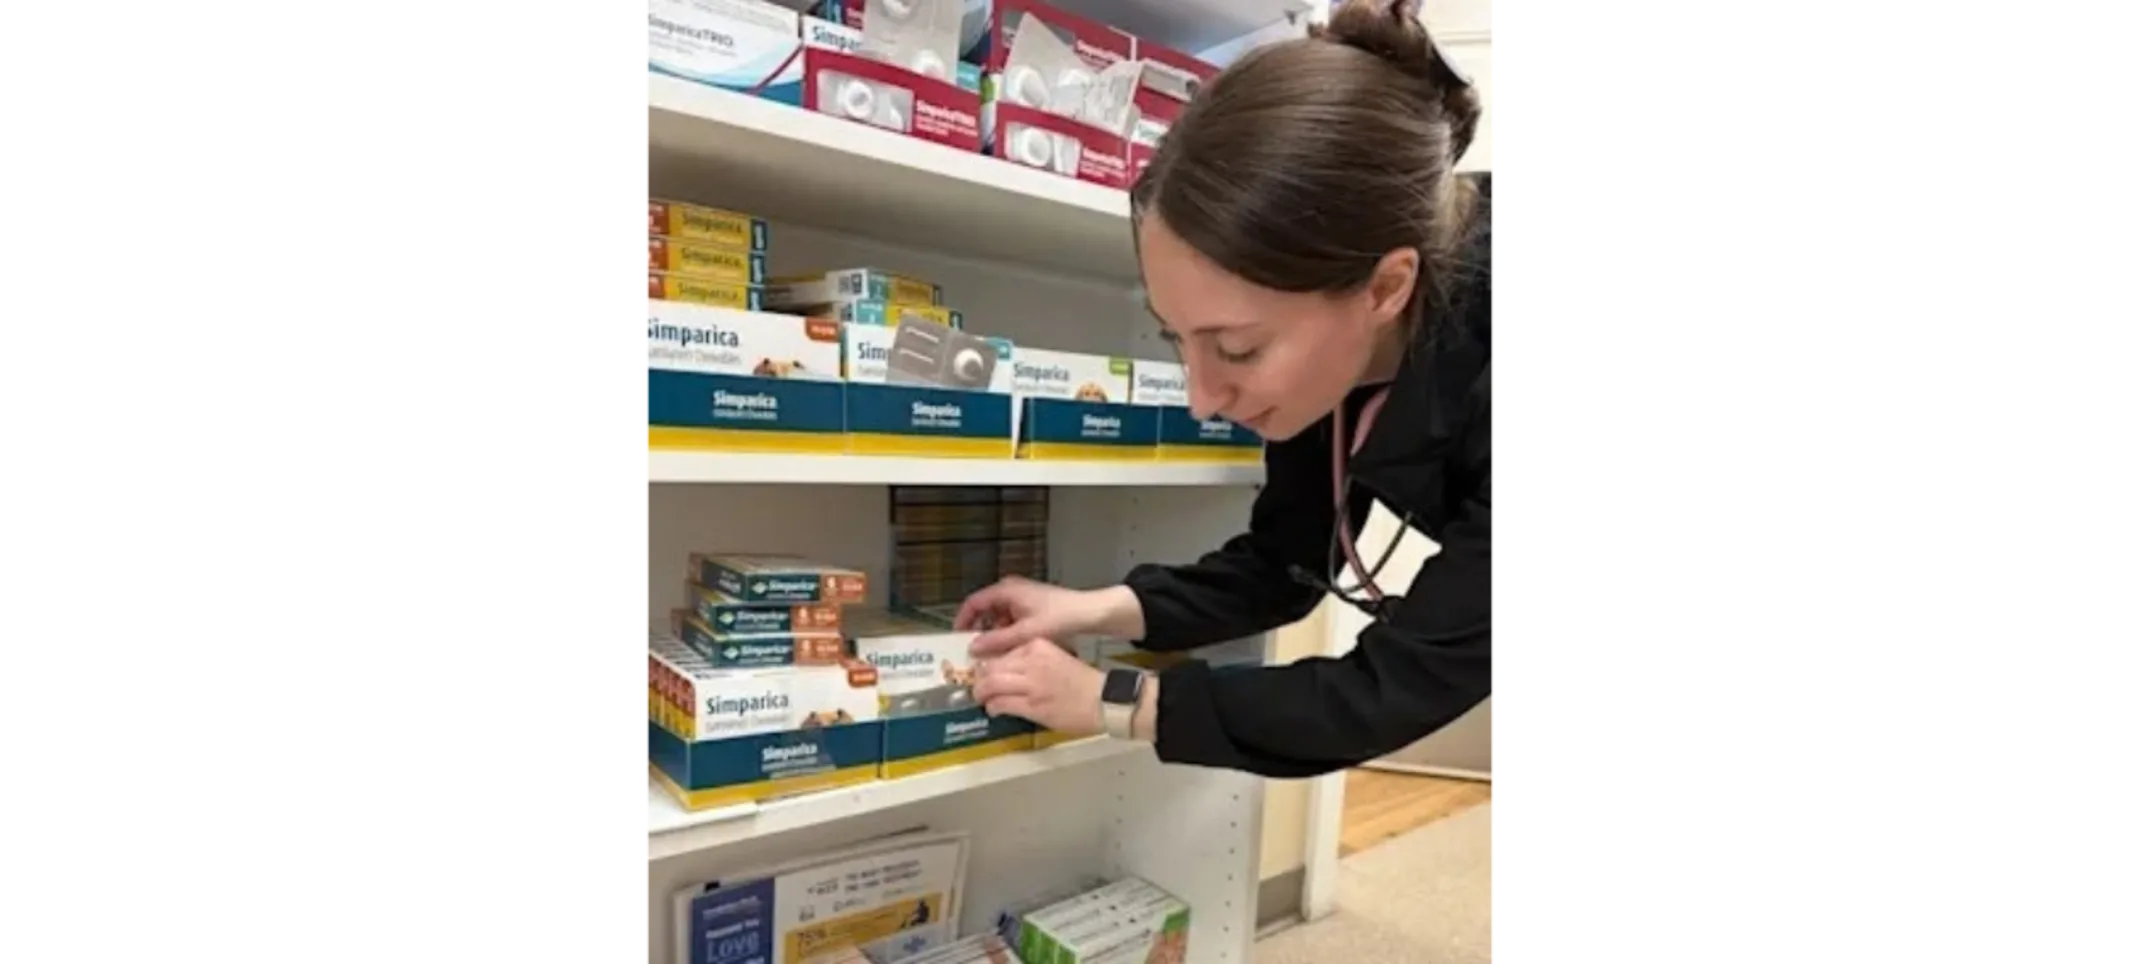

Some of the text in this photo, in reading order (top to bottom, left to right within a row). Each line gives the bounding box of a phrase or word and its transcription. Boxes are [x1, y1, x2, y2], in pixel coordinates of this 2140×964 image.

[812, 26, 867, 59] Simpar
[858, 340, 892, 362] Sim
[1013, 361, 1070, 383] Simparica
[713, 389, 778, 410] Simparica
[912, 400, 962, 420] Simparica
[865, 647, 934, 670] Simparica
[706, 691, 789, 717] Simparica
